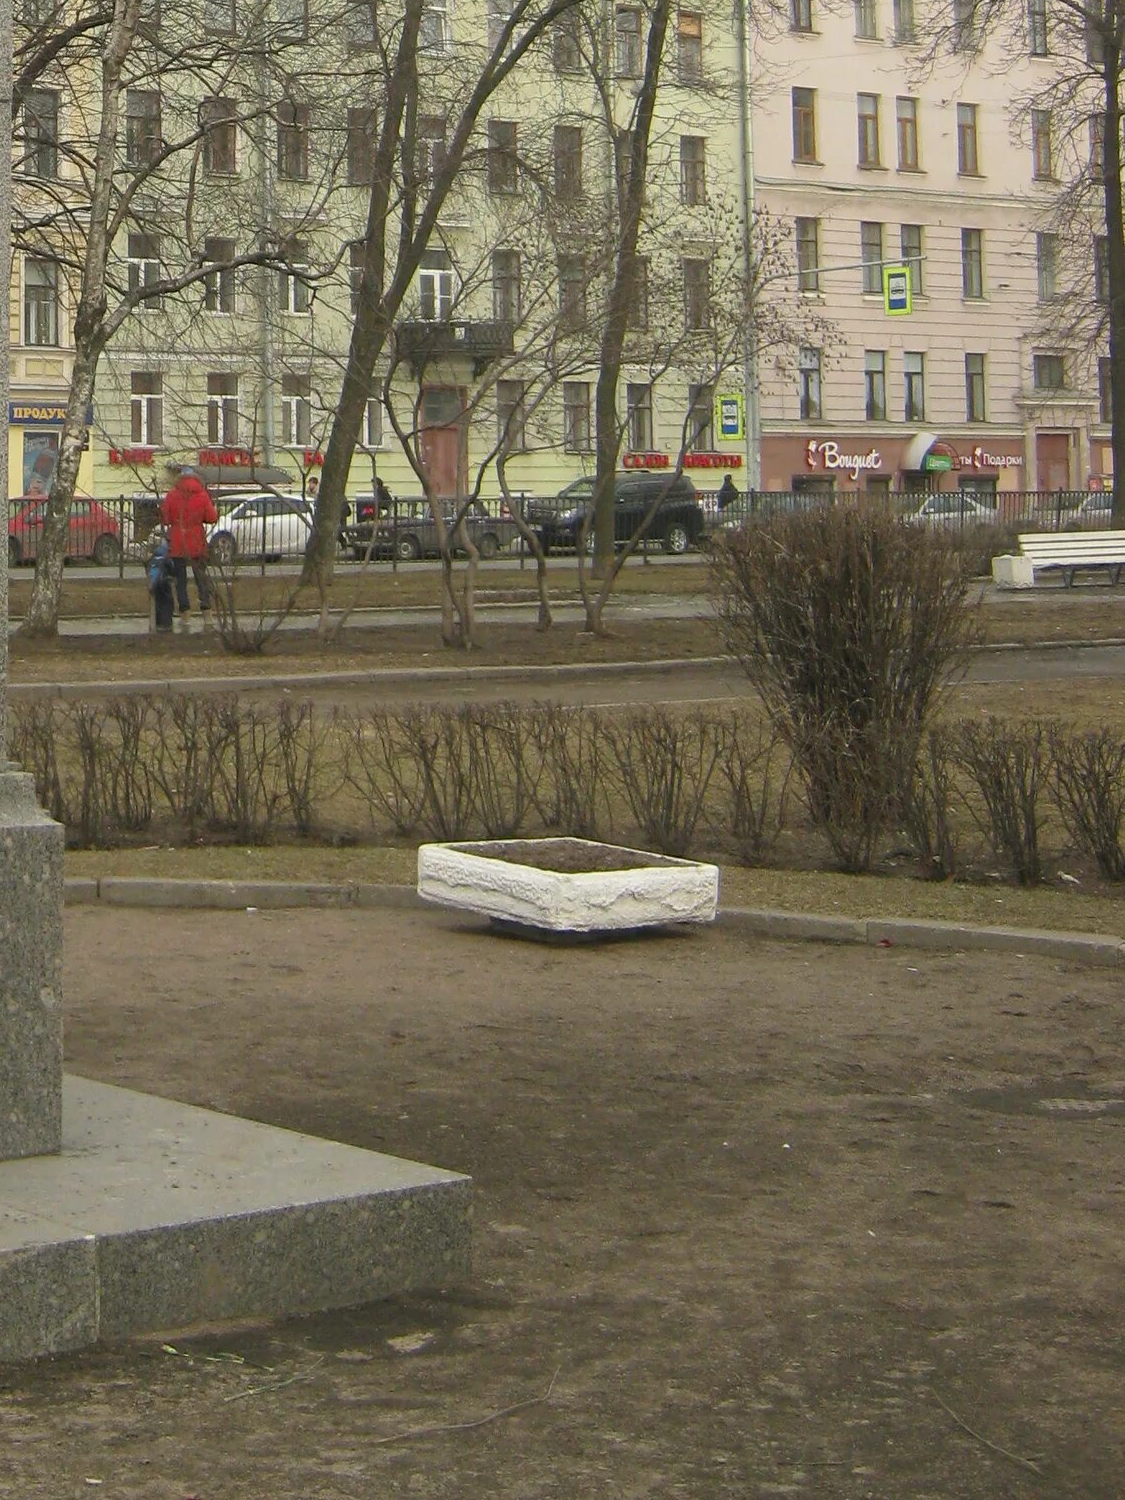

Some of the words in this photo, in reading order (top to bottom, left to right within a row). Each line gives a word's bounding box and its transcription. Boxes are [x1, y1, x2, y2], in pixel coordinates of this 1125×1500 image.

[13, 407, 67, 420] ПРОДУК
[305, 451, 325, 467] БА
[983, 453, 1022, 468] Подарки
